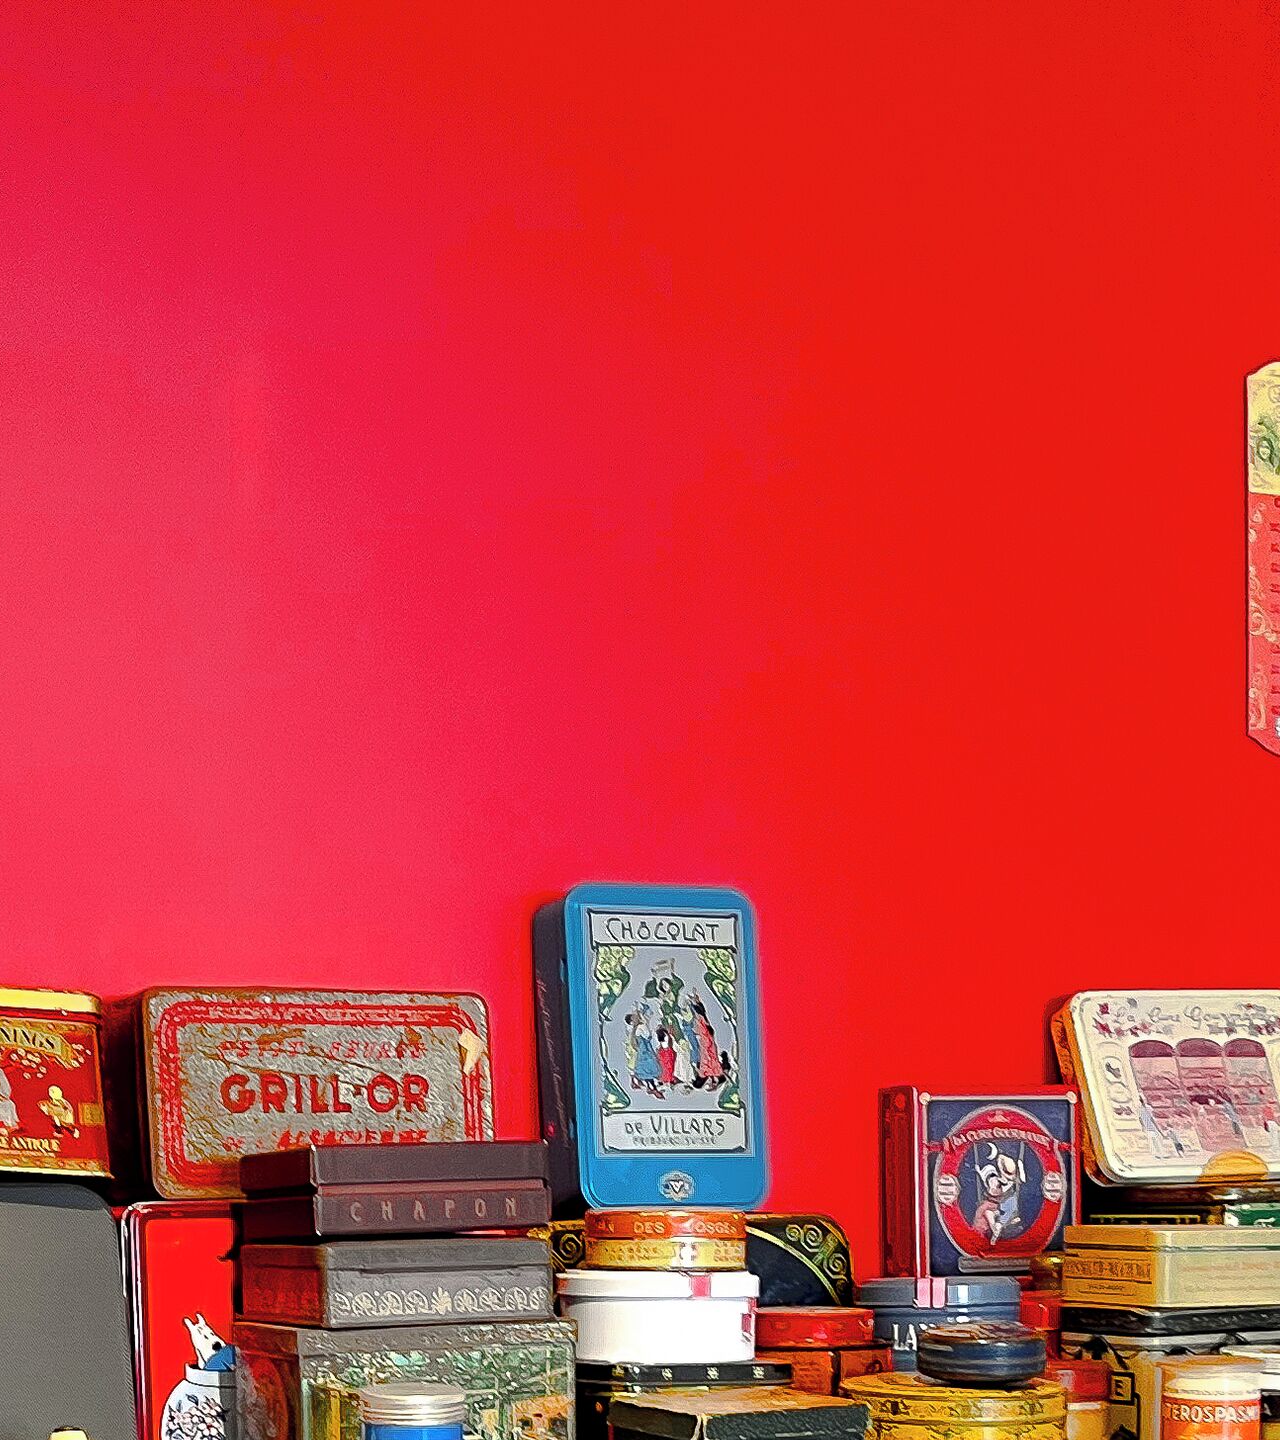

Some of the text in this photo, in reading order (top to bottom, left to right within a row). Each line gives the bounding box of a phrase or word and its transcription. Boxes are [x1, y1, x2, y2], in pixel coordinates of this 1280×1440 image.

[605, 917, 721, 943] CHOCOLAT
[649, 1114, 726, 1137] VILLARS
[349, 1195, 518, 1223] CHAPON
[892, 1323, 936, 1351] LA
